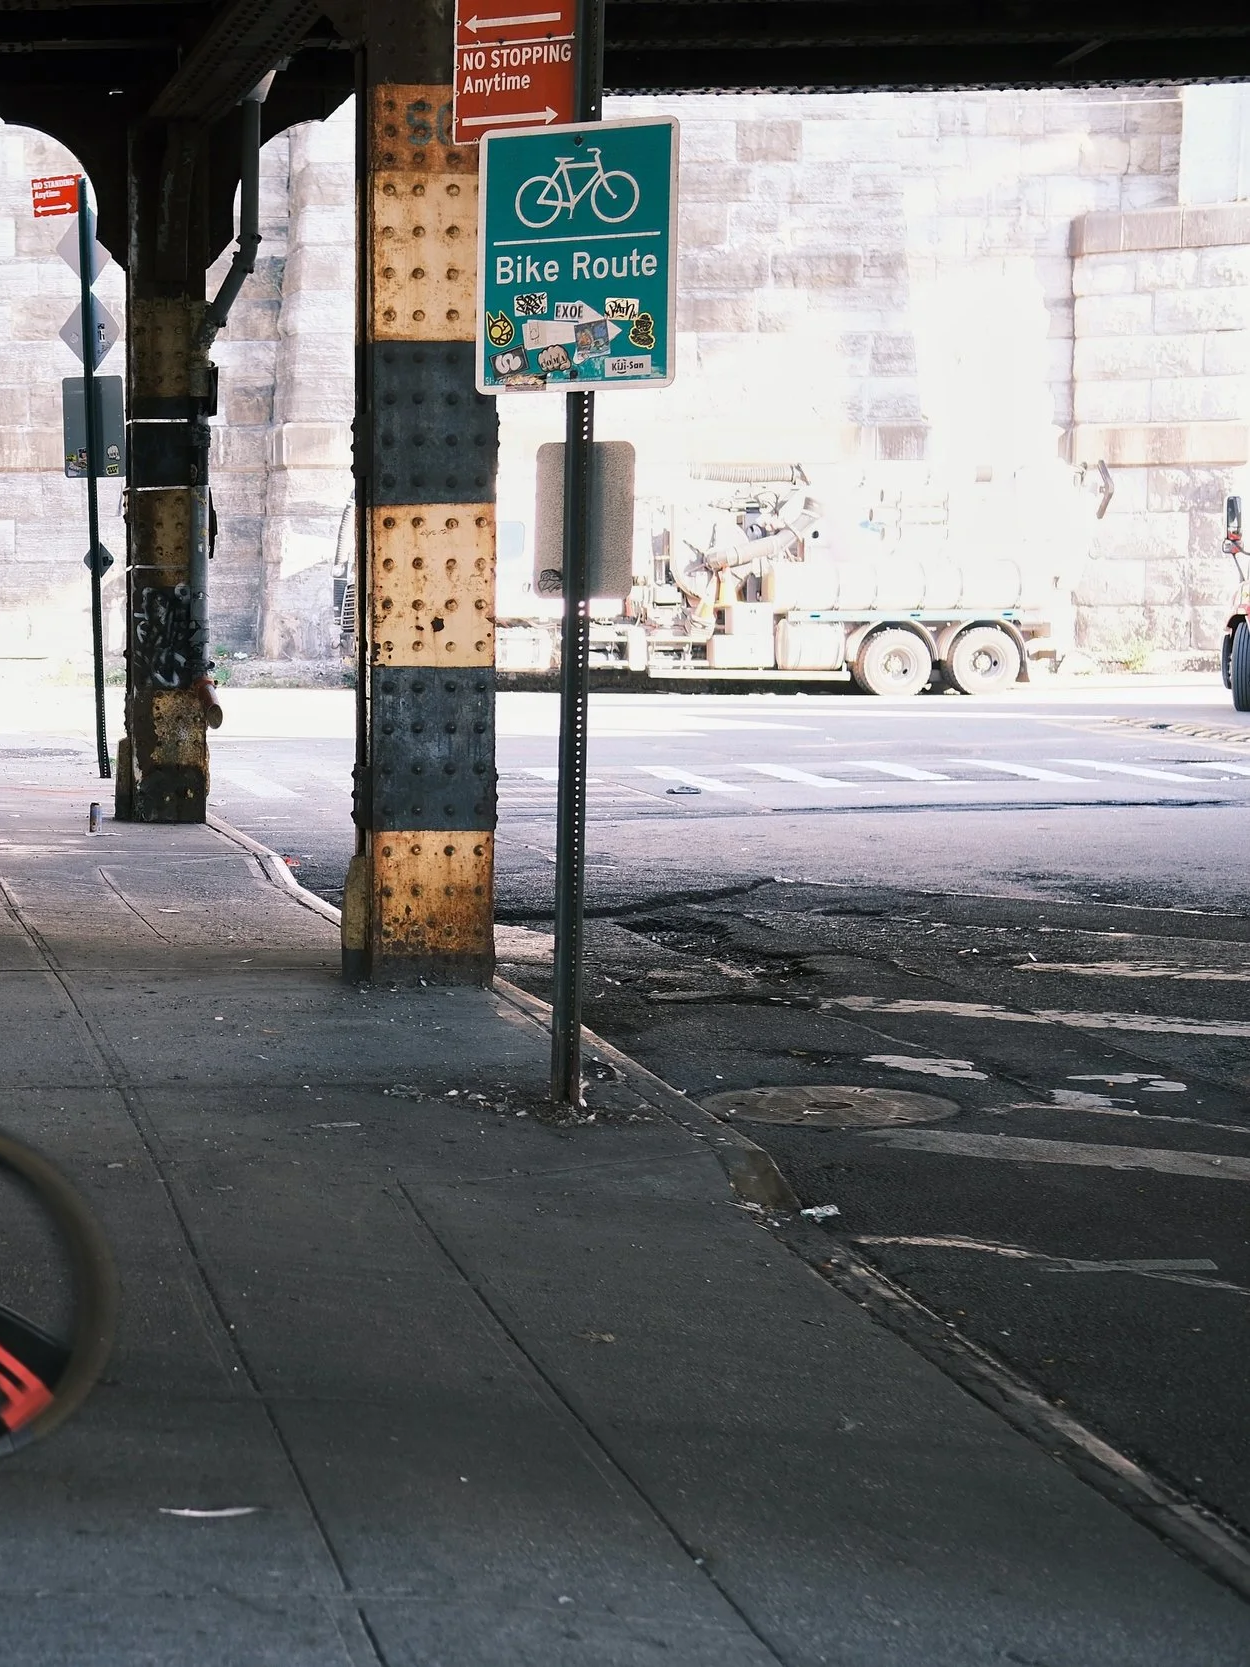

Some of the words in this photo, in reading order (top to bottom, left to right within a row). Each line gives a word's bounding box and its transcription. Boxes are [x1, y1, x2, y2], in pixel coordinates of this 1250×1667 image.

[462, 51, 485, 71] NO
[490, 43, 571, 69] STOPPING
[462, 73, 530, 96] Anytime
[33, 182, 43, 190] NO
[35, 190, 60, 199] Anytime
[496, 255, 559, 285] Bike
[573, 248, 657, 280] Route
